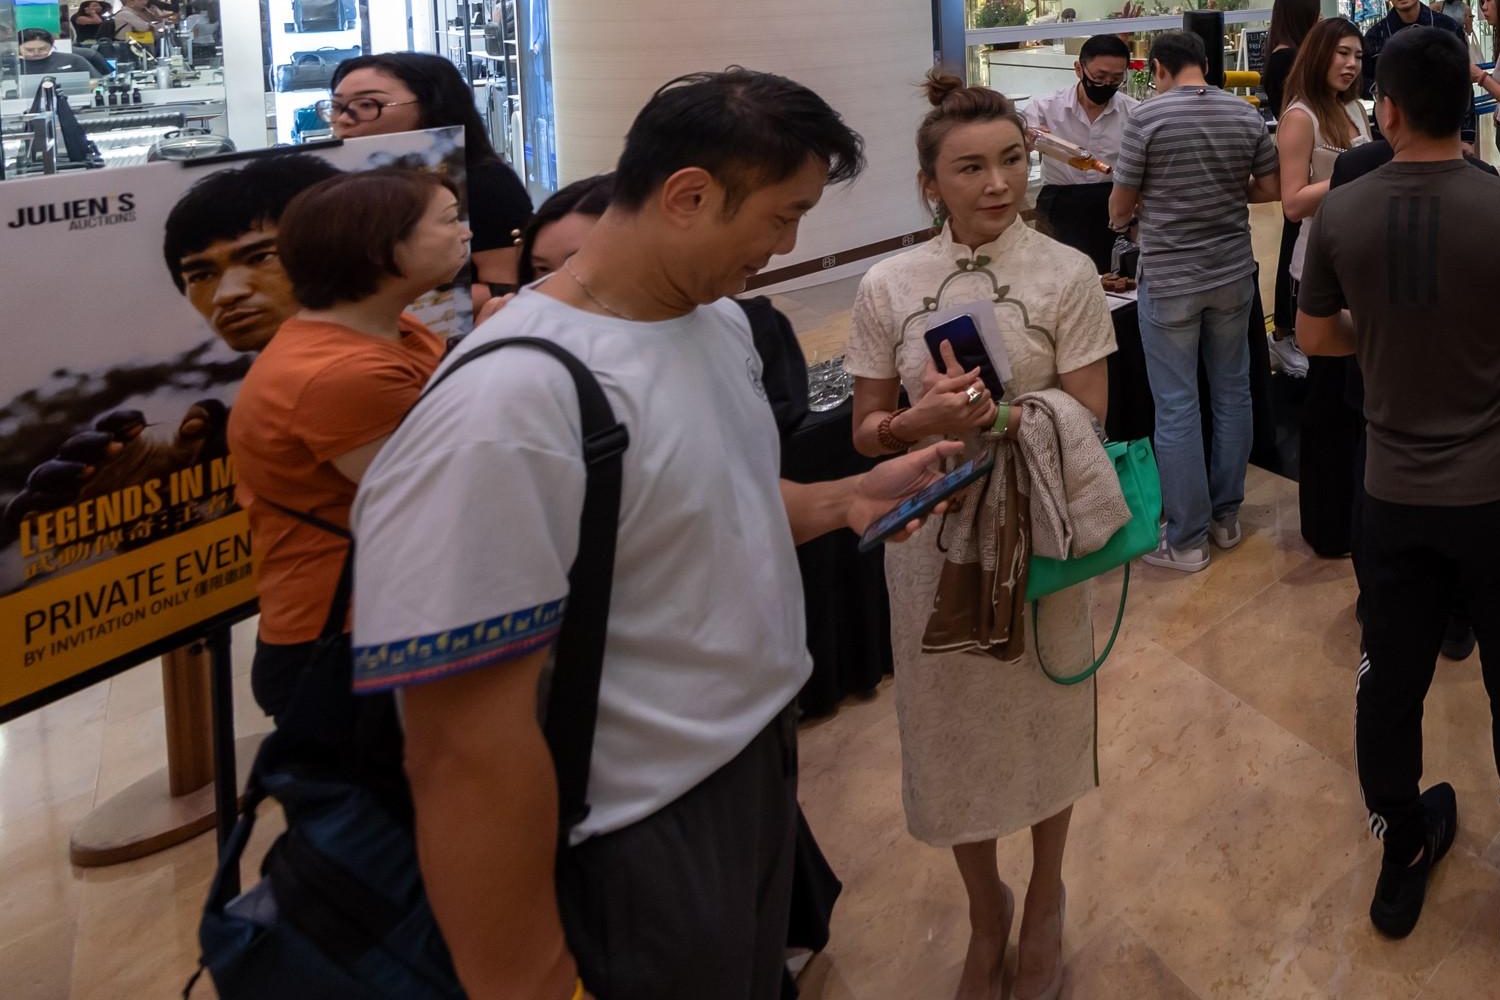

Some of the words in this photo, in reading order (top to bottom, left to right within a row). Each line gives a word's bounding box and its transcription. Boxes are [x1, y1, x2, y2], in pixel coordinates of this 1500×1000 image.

[8, 192, 135, 229] JULIEN'S
[69, 211, 137, 231] AUCTIONS
[20, 477, 162, 558] LEGENDS
[169, 463, 204, 506] IN
[23, 646, 47, 668] BY
[50, 606, 146, 657] INVITATION
[150, 588, 190, 616] ONLY
[24, 562, 166, 646] PRIVATE
